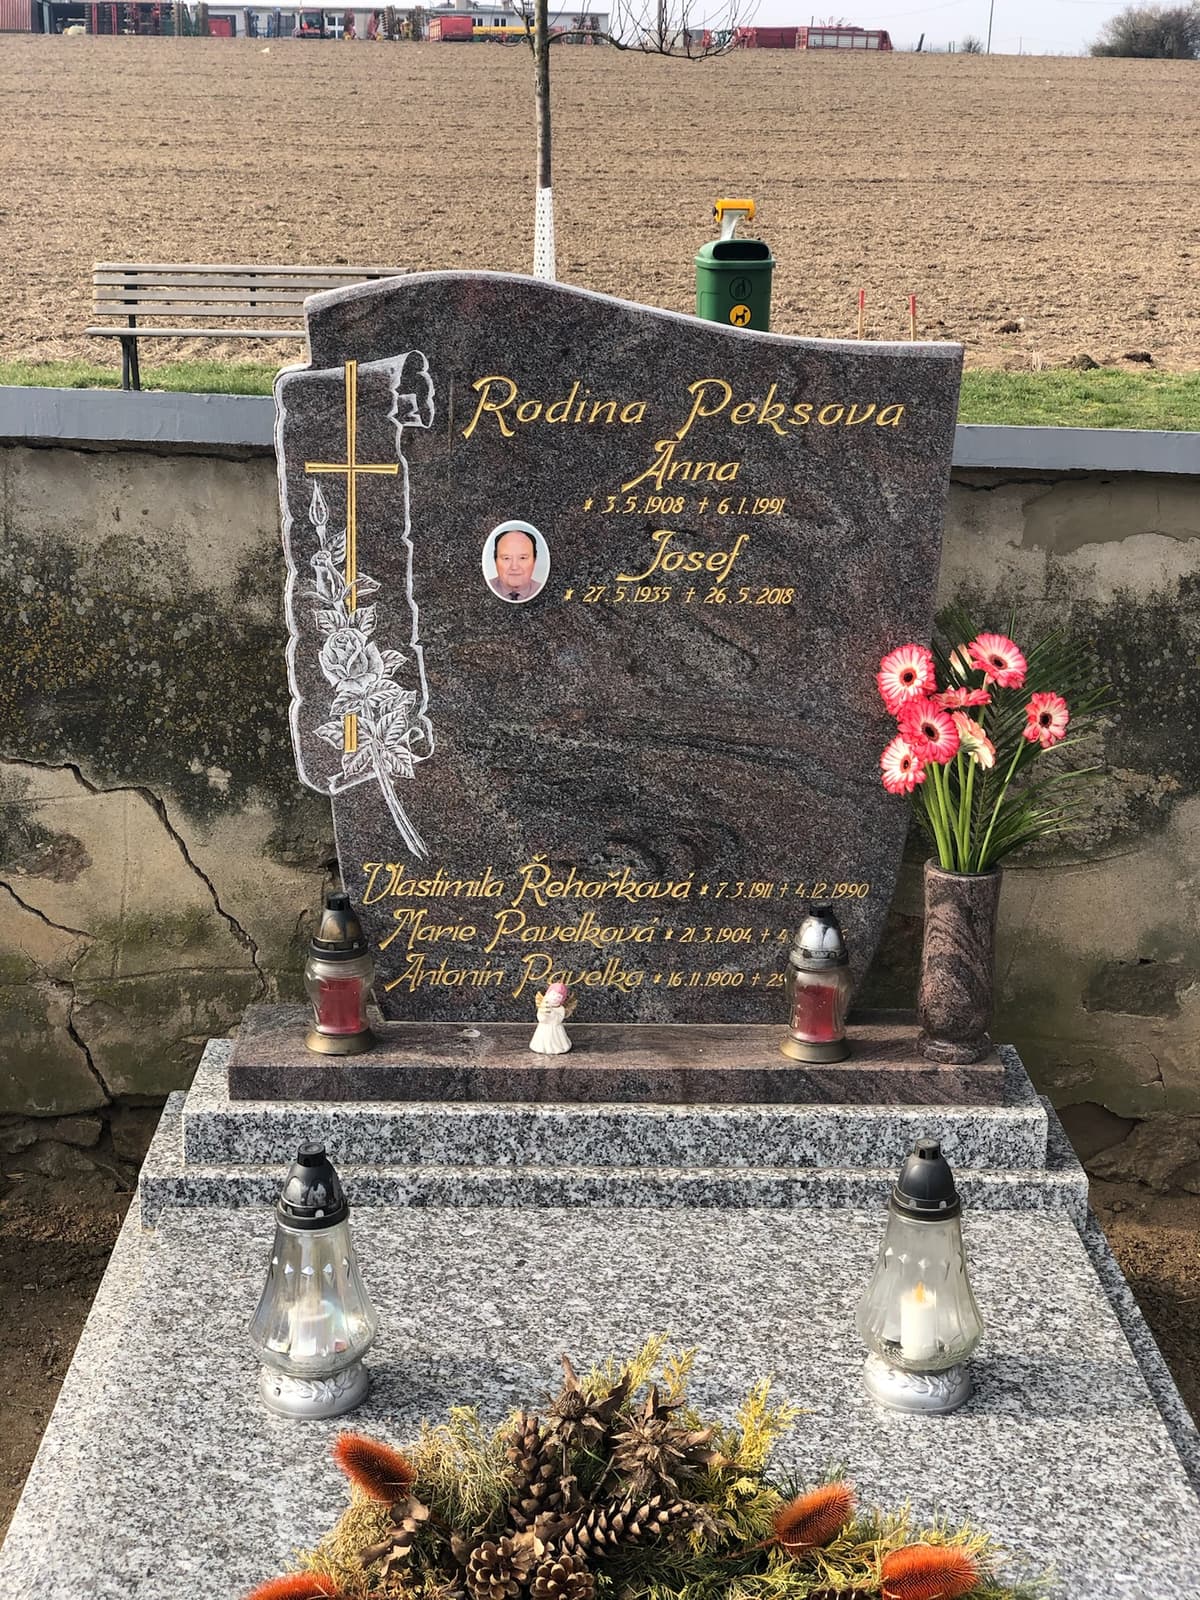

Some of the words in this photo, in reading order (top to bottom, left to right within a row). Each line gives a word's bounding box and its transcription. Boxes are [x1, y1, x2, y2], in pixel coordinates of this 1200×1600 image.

[462, 376, 648, 439] Rodina
[676, 378, 905, 440] Peksova
[621, 439, 741, 493] Anna
[615, 529, 750, 584] Josef
[363, 862, 505, 905] Vlastimila
[511, 853, 695, 908] Řehořková
[378, 908, 477, 951] Marie
[483, 908, 661, 954] Pavelková
[384, 952, 504, 993] Antonín
[511, 952, 646, 999] Pavelka
